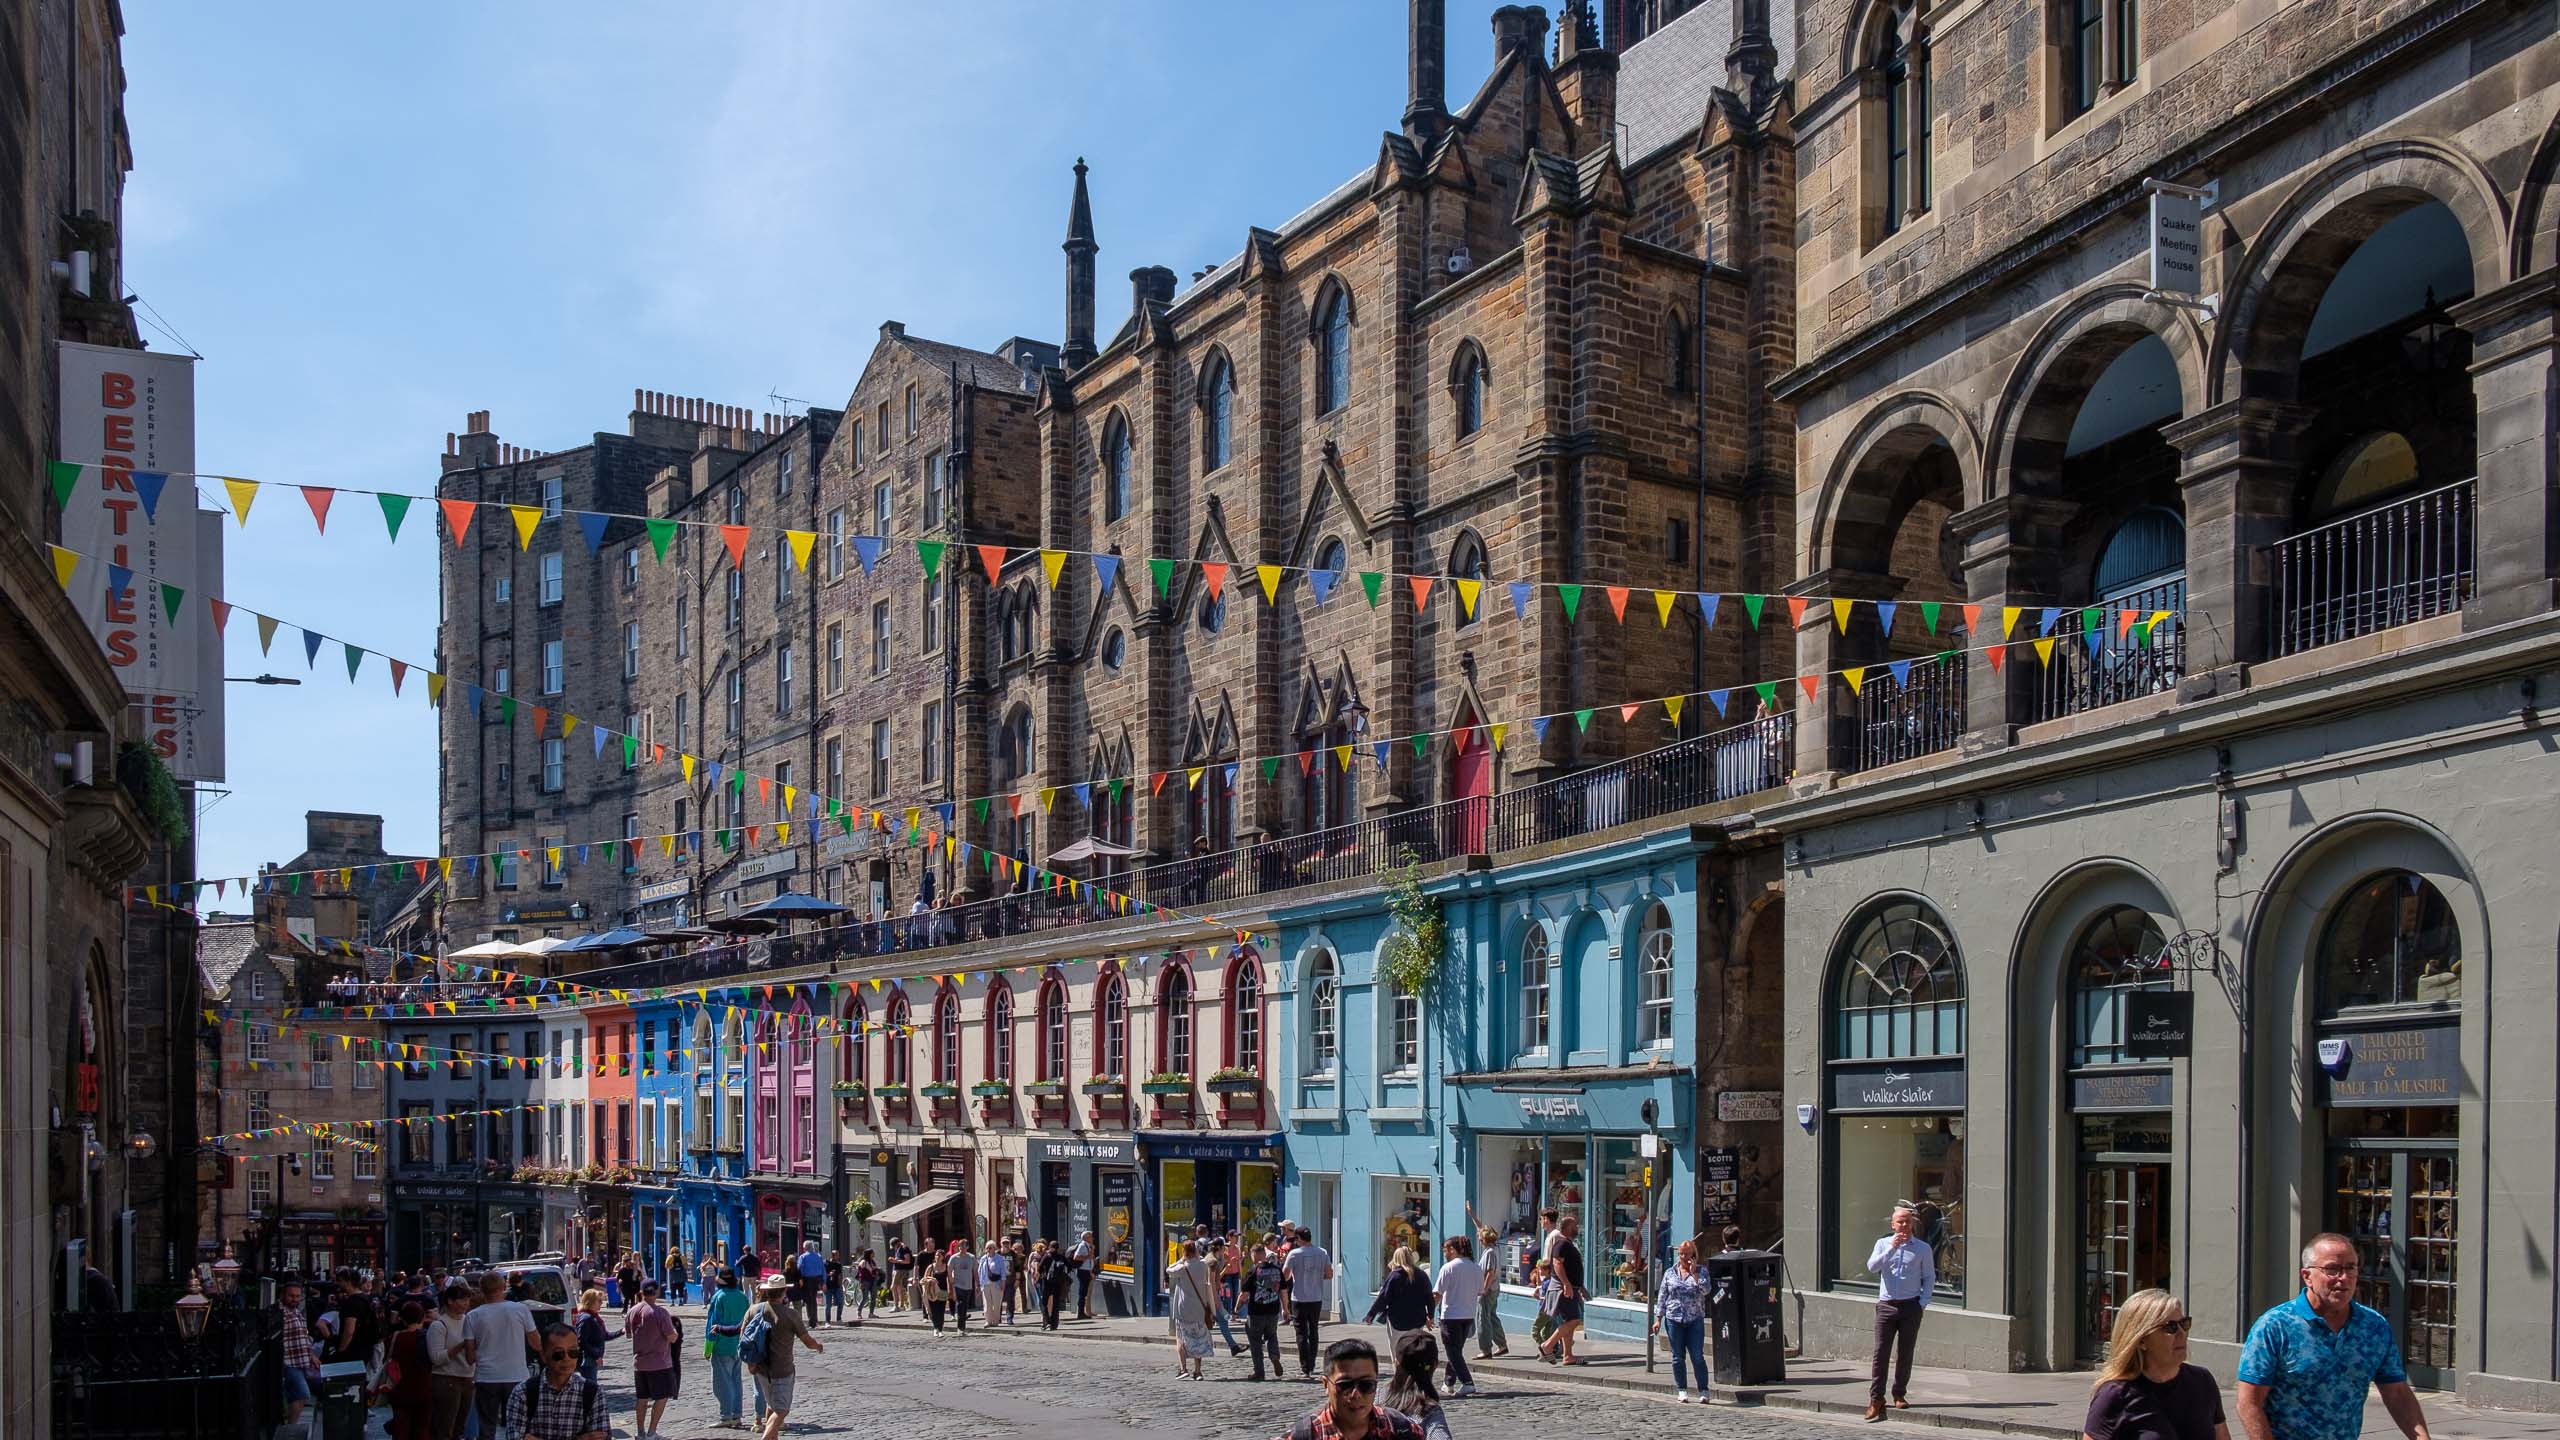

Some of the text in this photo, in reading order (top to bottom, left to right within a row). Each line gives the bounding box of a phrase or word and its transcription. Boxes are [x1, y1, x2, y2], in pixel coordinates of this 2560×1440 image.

[2161, 216, 2196, 232] Quaker
[2160, 236, 2198, 255] Meeting
[2163, 257, 2194, 272] House
[147, 377, 156, 468] PROPER FISH
[101, 371, 138, 667] BERTIES
[149, 643, 157, 669] BAR
[640, 881, 678, 901] MAXIES
[2132, 1030, 2185, 1040] Walker Slater
[2360, 1031, 2425, 1049] TAILORED
[2357, 1046, 2425, 1063] SUITS TO FIT
[2384, 1063, 2396, 1078] &
[1863, 1086, 1934, 1103] Walker Slater
[2336, 1078, 2449, 1095] MADE TO MEASURE
[1520, 1097, 1580, 1116] SWISH
[1046, 1145, 1119, 1158] THE WHISKY SHOP
[1708, 1155, 1733, 1163] SCOTTS
